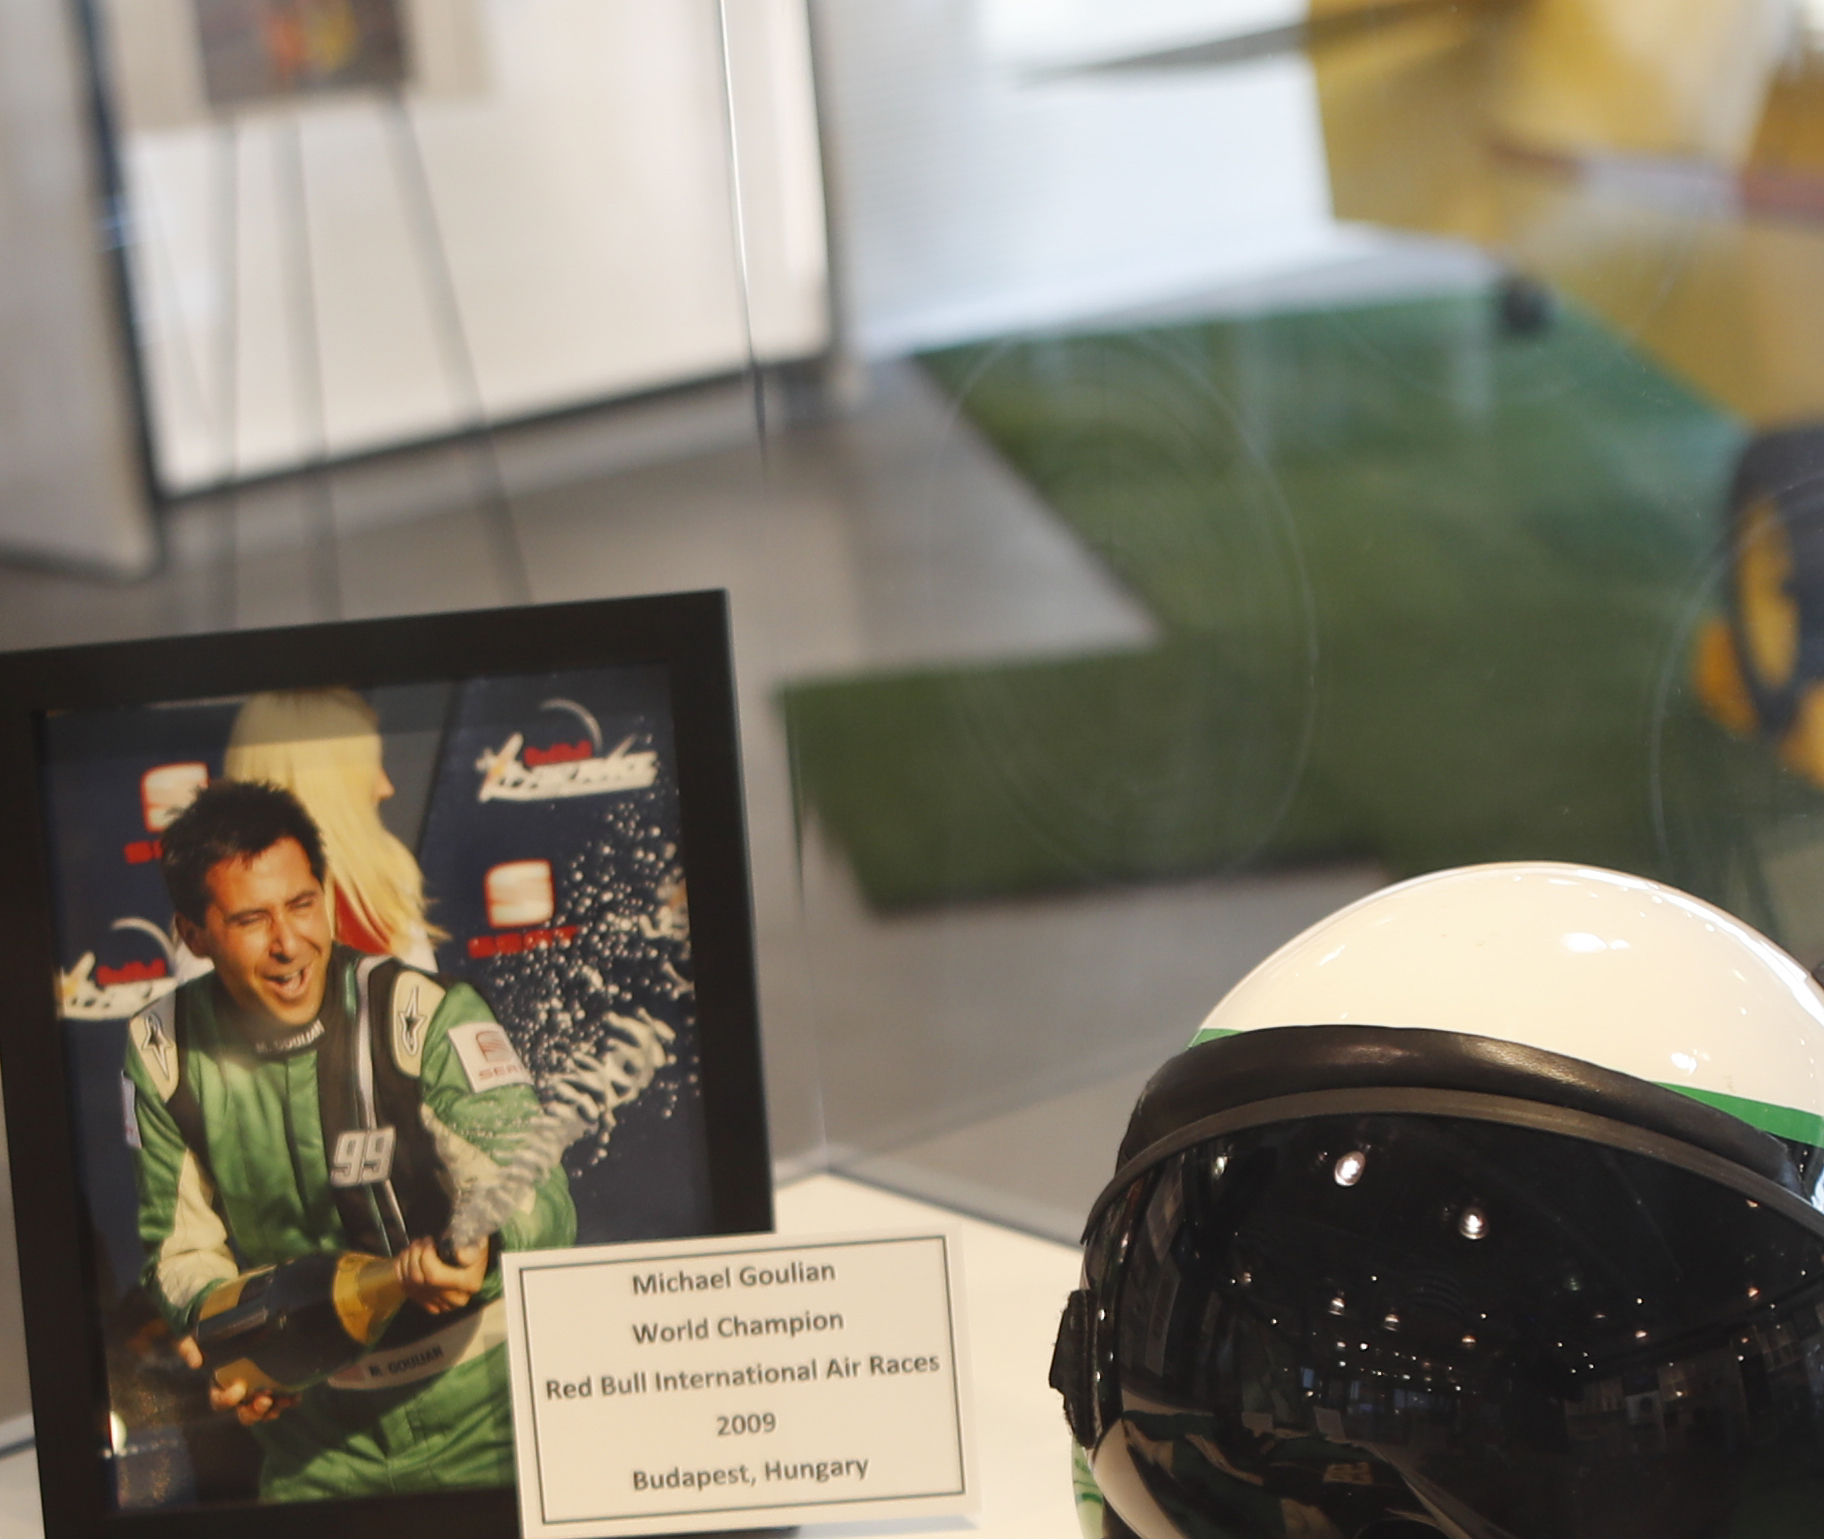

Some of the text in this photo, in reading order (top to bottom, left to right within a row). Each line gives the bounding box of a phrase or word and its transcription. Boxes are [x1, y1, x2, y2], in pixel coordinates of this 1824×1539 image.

[330, 1125, 396, 1188] 99
[632, 1260, 836, 1295] Michael Goulian
[632, 1309, 844, 1344] World Champion
[546, 1352, 941, 1400] Red Bull International Air Races
[716, 1412, 777, 1437] 2009
[632, 1455, 870, 1491] Budapest, Hungary
